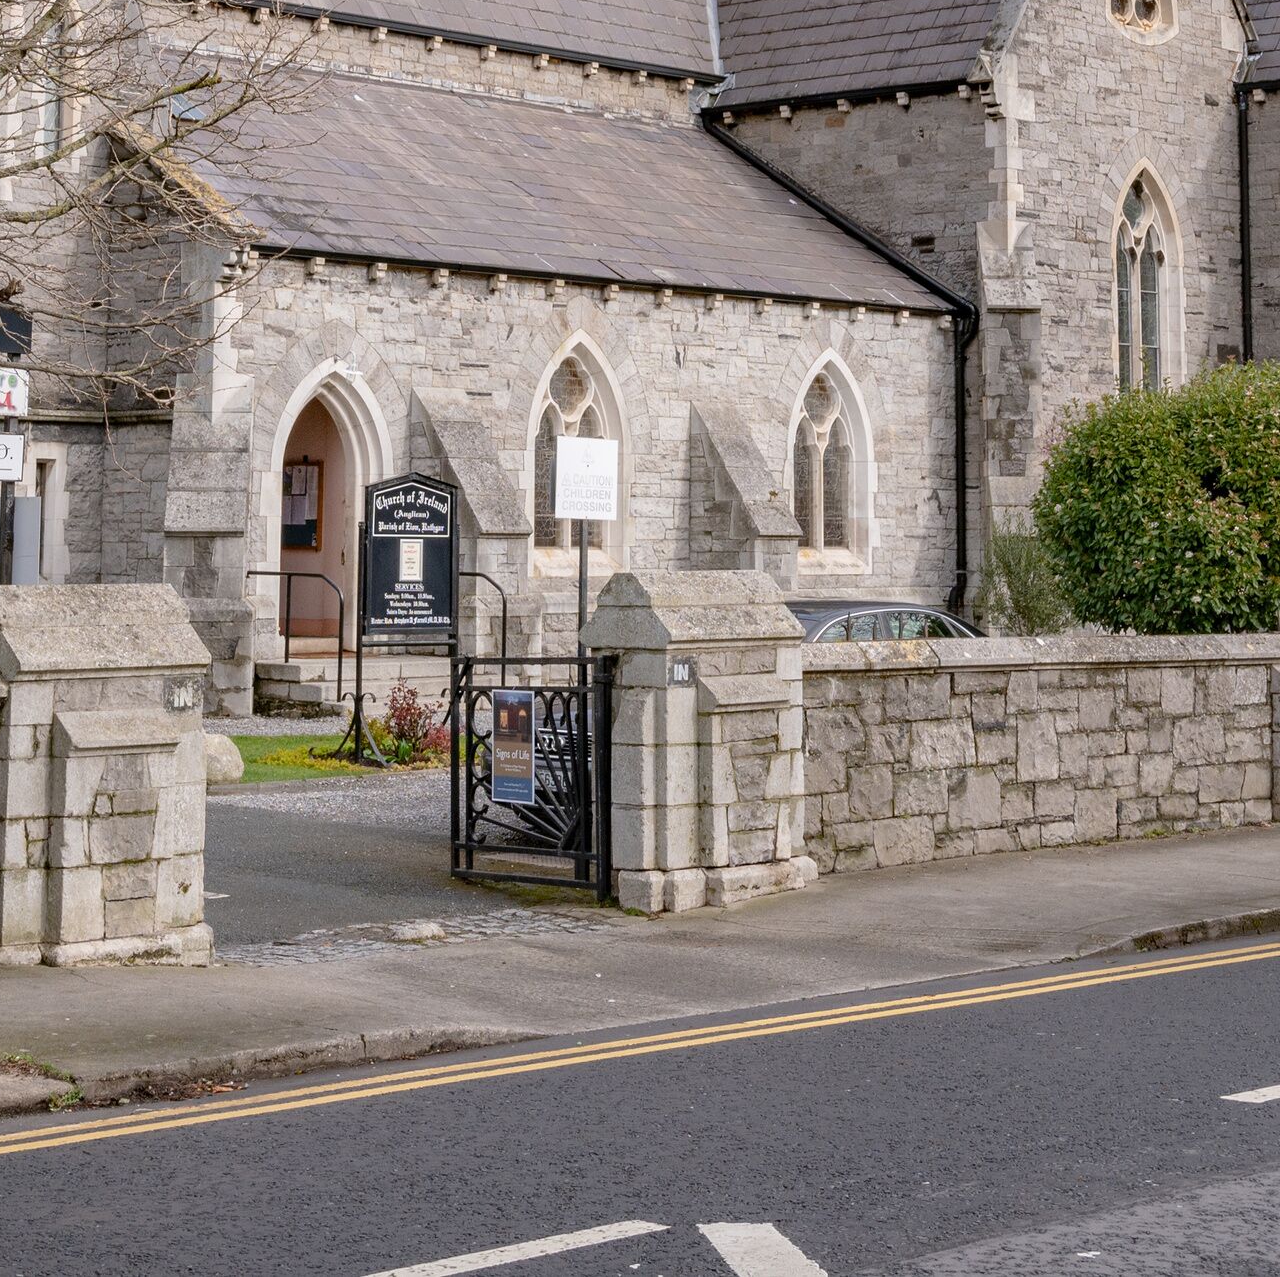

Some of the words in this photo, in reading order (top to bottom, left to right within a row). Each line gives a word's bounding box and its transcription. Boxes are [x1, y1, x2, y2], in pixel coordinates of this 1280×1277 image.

[563, 488, 611, 500] CHILDREN
[376, 491, 405, 510] Church
[407, 491, 415, 503] of
[416, 491, 448, 514] Ireland
[562, 501, 612, 513] CROSSING
[394, 509, 430, 519] (Anglican)
[673, 664, 689, 680] IN
[173, 683, 193, 708] IN
[496, 748, 510, 760] Signs
[512, 750, 518, 759] of
[519, 750, 530, 760] Life
